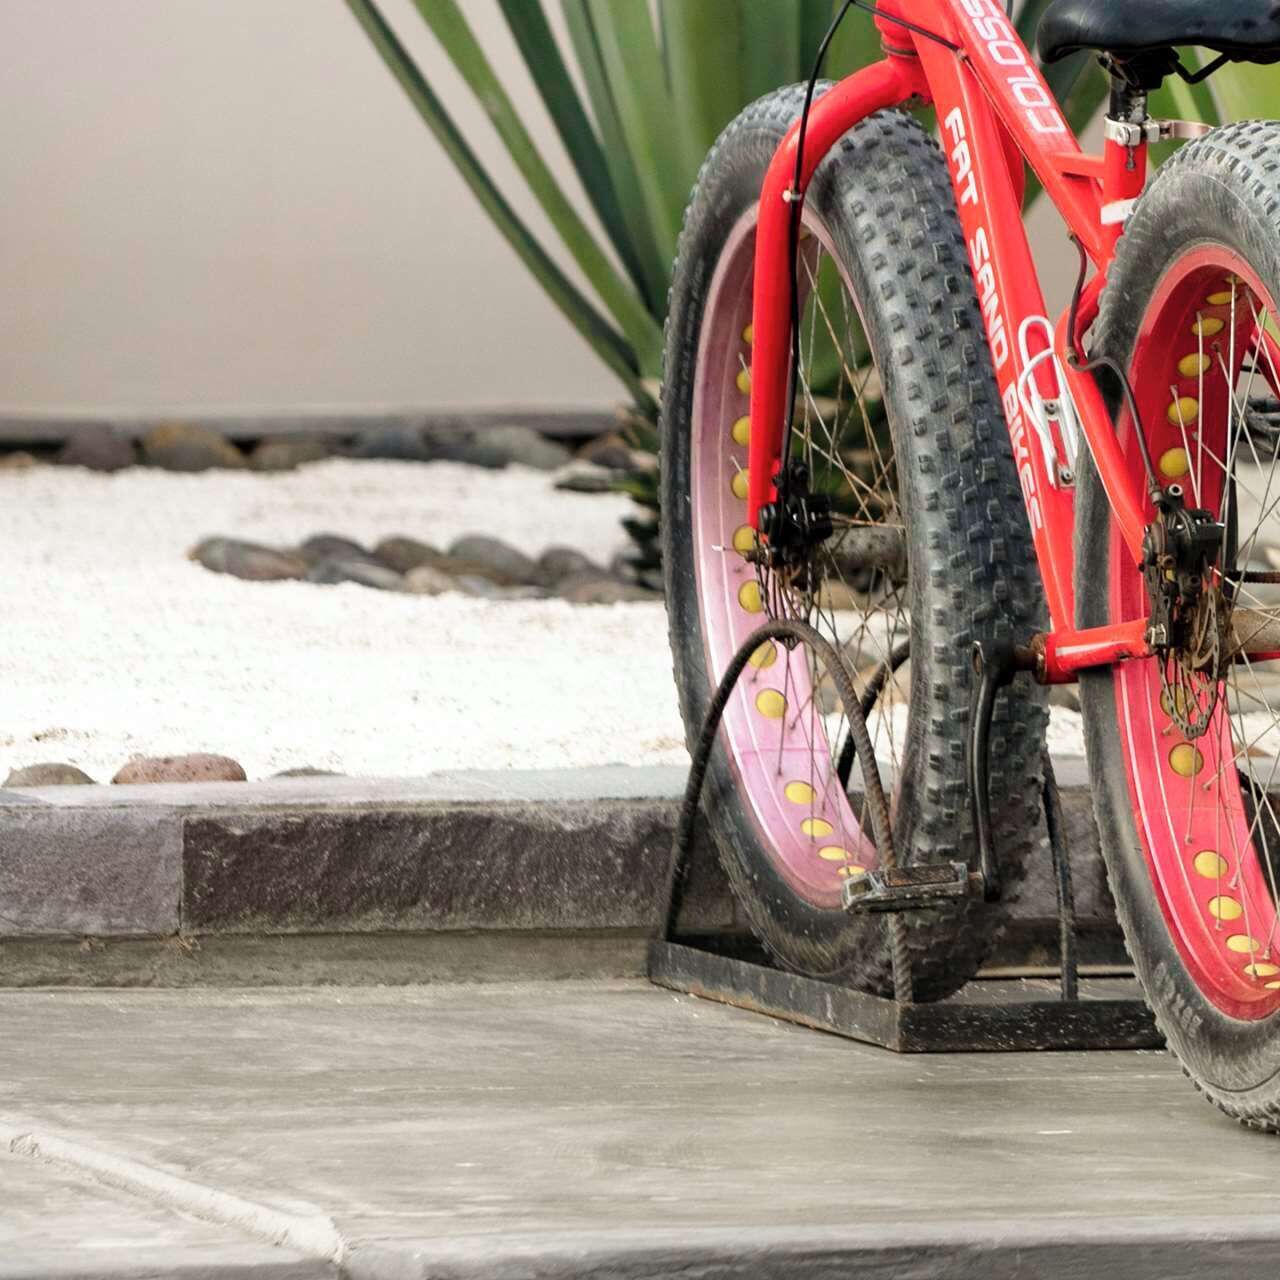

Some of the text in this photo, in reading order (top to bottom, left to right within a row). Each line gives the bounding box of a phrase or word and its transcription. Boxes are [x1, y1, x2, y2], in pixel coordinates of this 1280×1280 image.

[944, 106, 1043, 539] FAT SAND BIKES
